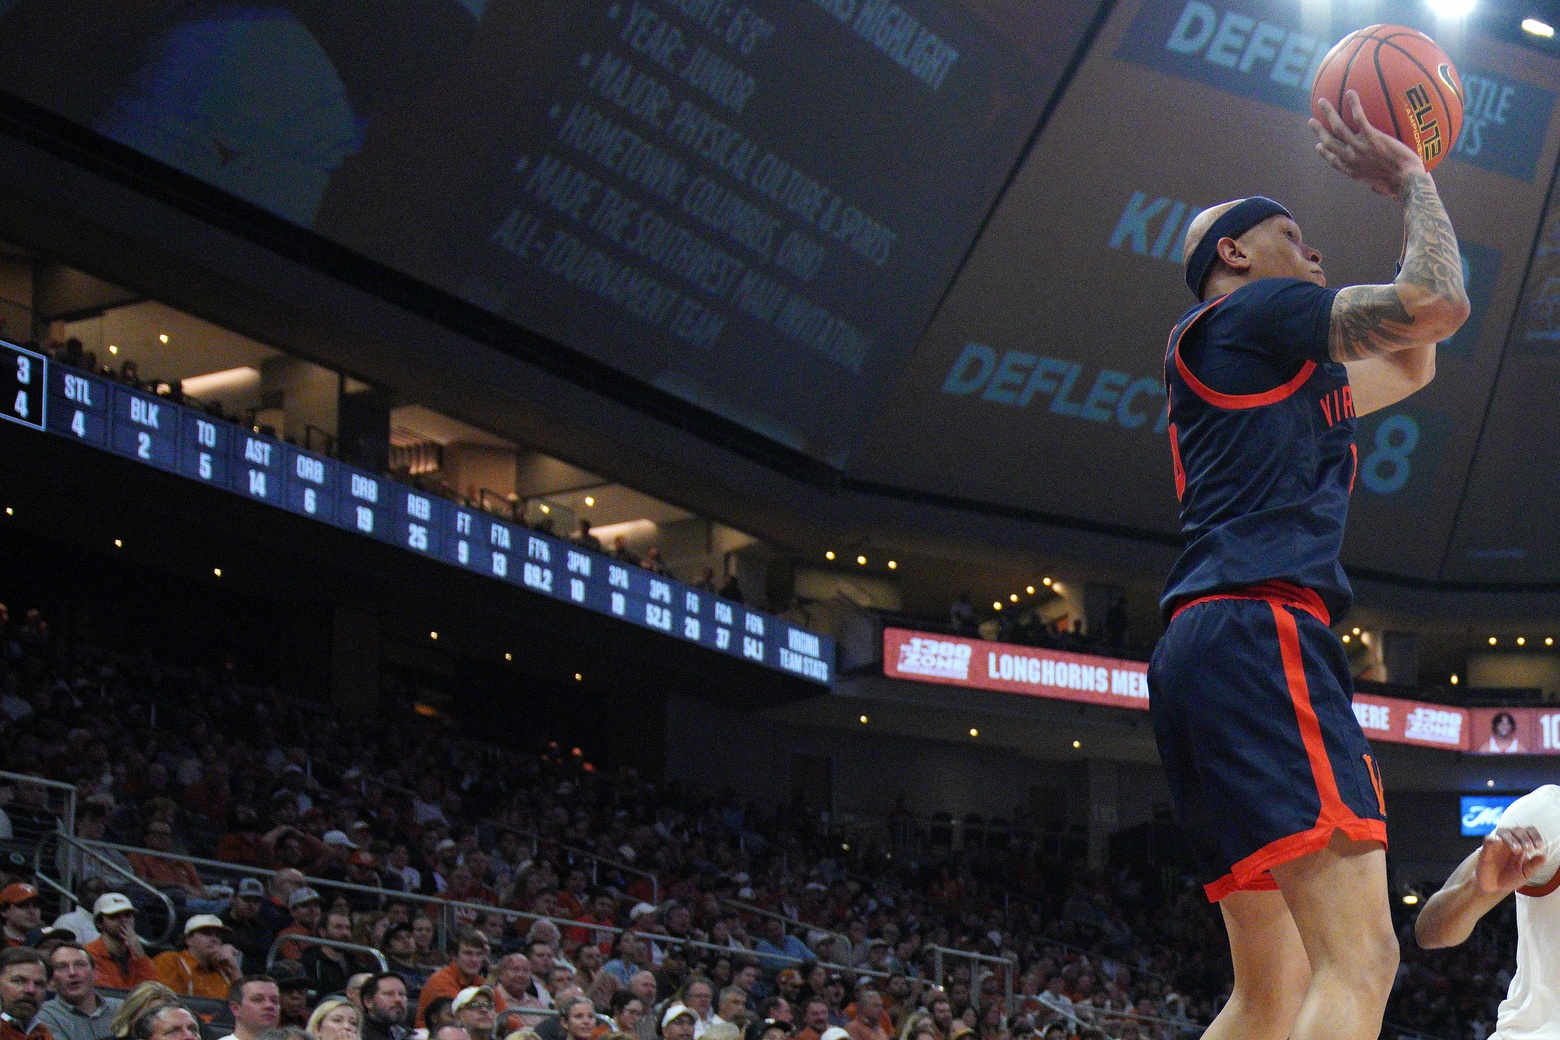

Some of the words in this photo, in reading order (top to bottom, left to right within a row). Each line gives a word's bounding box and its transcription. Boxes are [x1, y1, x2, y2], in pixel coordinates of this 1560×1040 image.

[620, 2, 687, 72] YEAR:
[679, 46, 757, 115] JUNIOR
[557, 102, 688, 202] HOMETOWN:
[587, 51, 671, 130] MAJOR:
[666, 100, 758, 181] PHYSICAL
[1406, 82, 1442, 162] ELITE
[523, 154, 601, 221] MADE
[17, 355, 30, 384] 3
[14, 391, 28, 418] 4
[71, 410, 86, 438] 4
[138, 432, 151, 459] 2
[199, 453, 212, 480] 5
[249, 469, 266, 498] 14
[304, 488, 316, 514] 6
[408, 523, 428, 551] 25
[64, 373, 92, 406] STL
[130, 396, 159, 429] BLK
[197, 419, 216, 447] TO
[245, 437, 271, 467] AST
[407, 493, 430, 521] REB
[457, 511, 472, 535] FT
[491, 523, 511, 549] FTA
[1361, 414, 1420, 494] 8
[988, 652, 1109, 694] LONGHORNS
